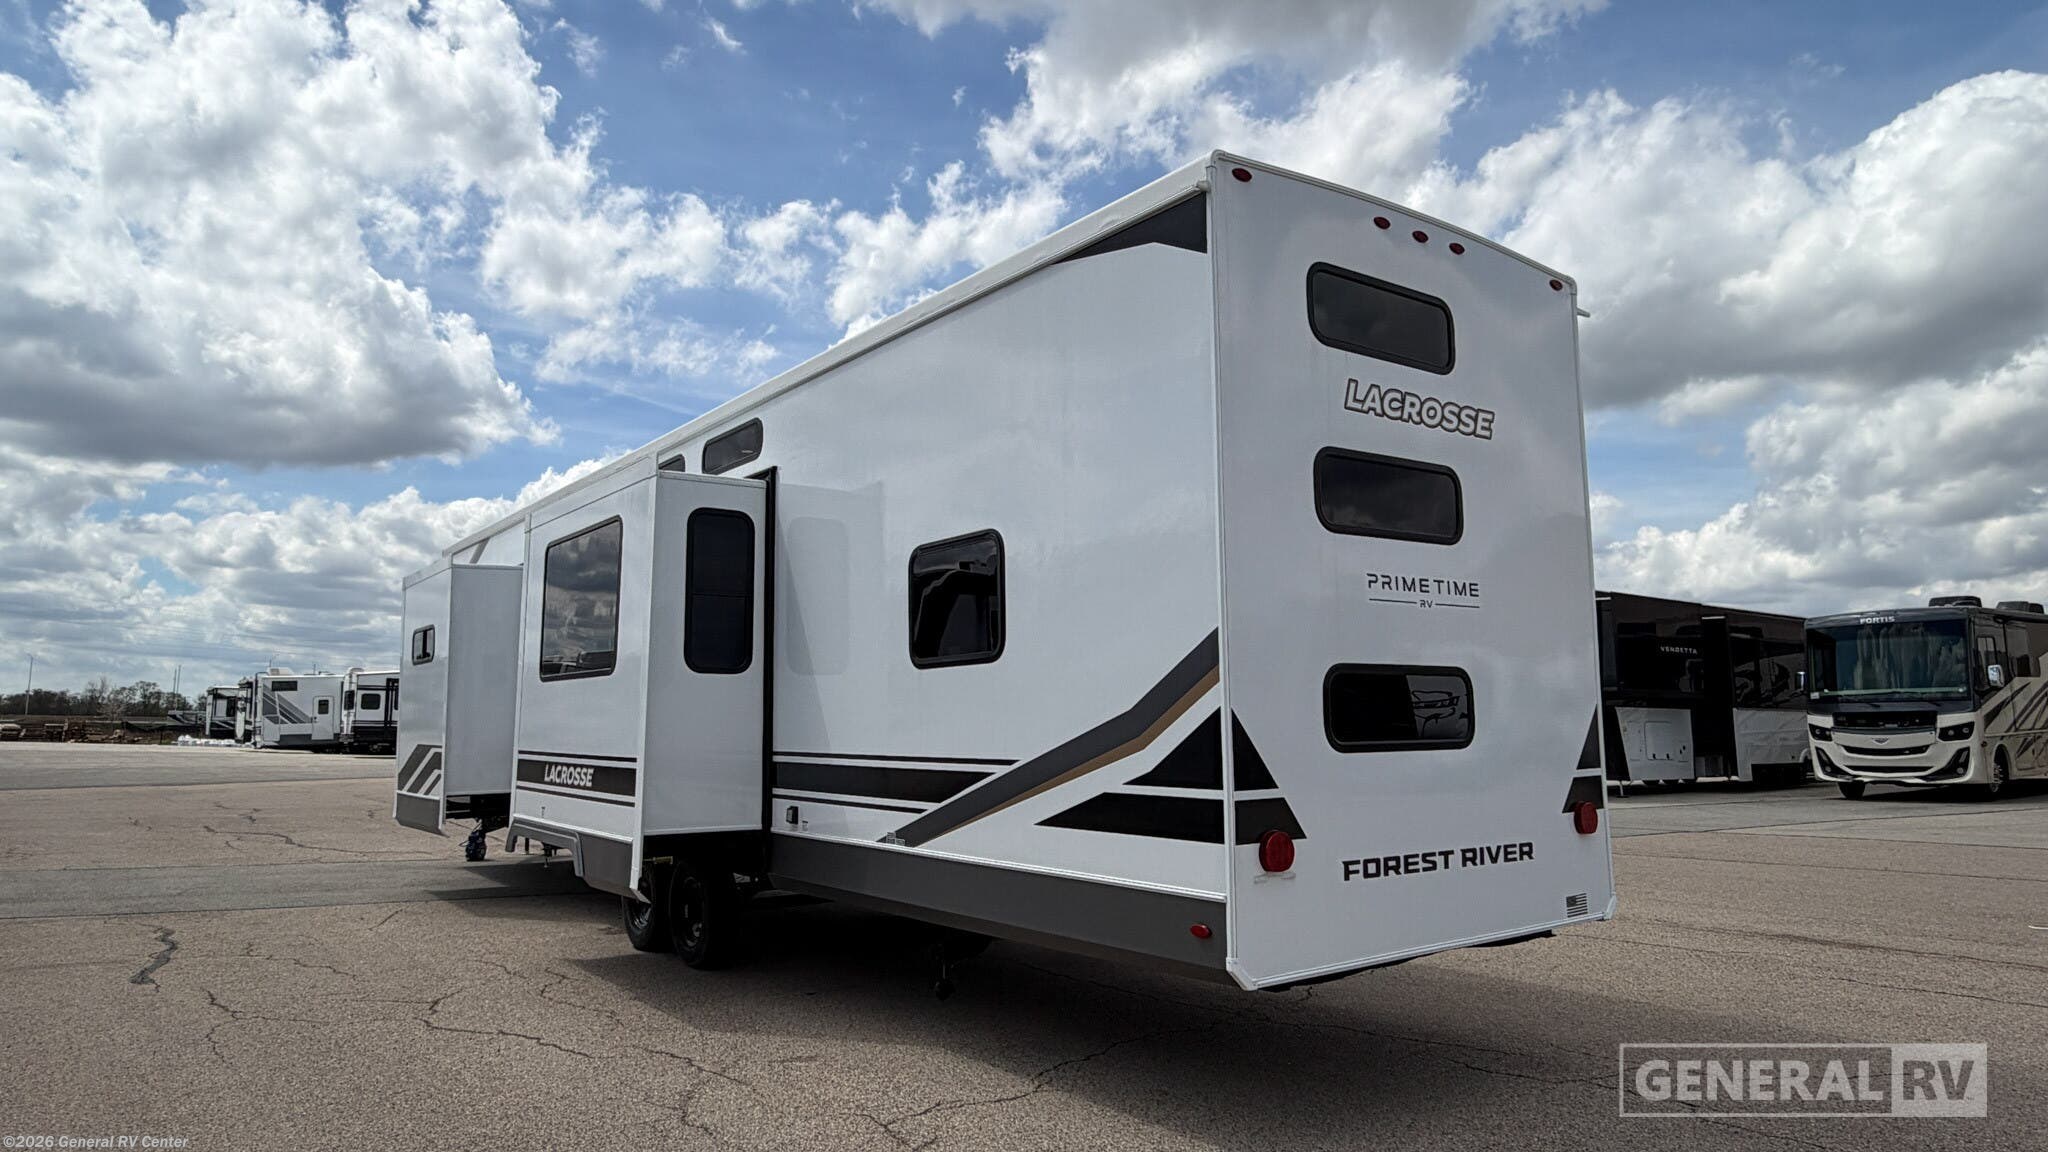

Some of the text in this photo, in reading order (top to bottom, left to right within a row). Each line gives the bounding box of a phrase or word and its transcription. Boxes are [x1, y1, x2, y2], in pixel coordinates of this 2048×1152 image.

[1344, 378, 1495, 440] LACROSSE
[1419, 599, 1434, 609] RV
[1860, 615, 1896, 625] FORTIS
[1660, 646, 1698, 655] VENDETTA
[544, 763, 595, 788] LACROSSE
[1341, 841, 1536, 882] FOREST RIVER
